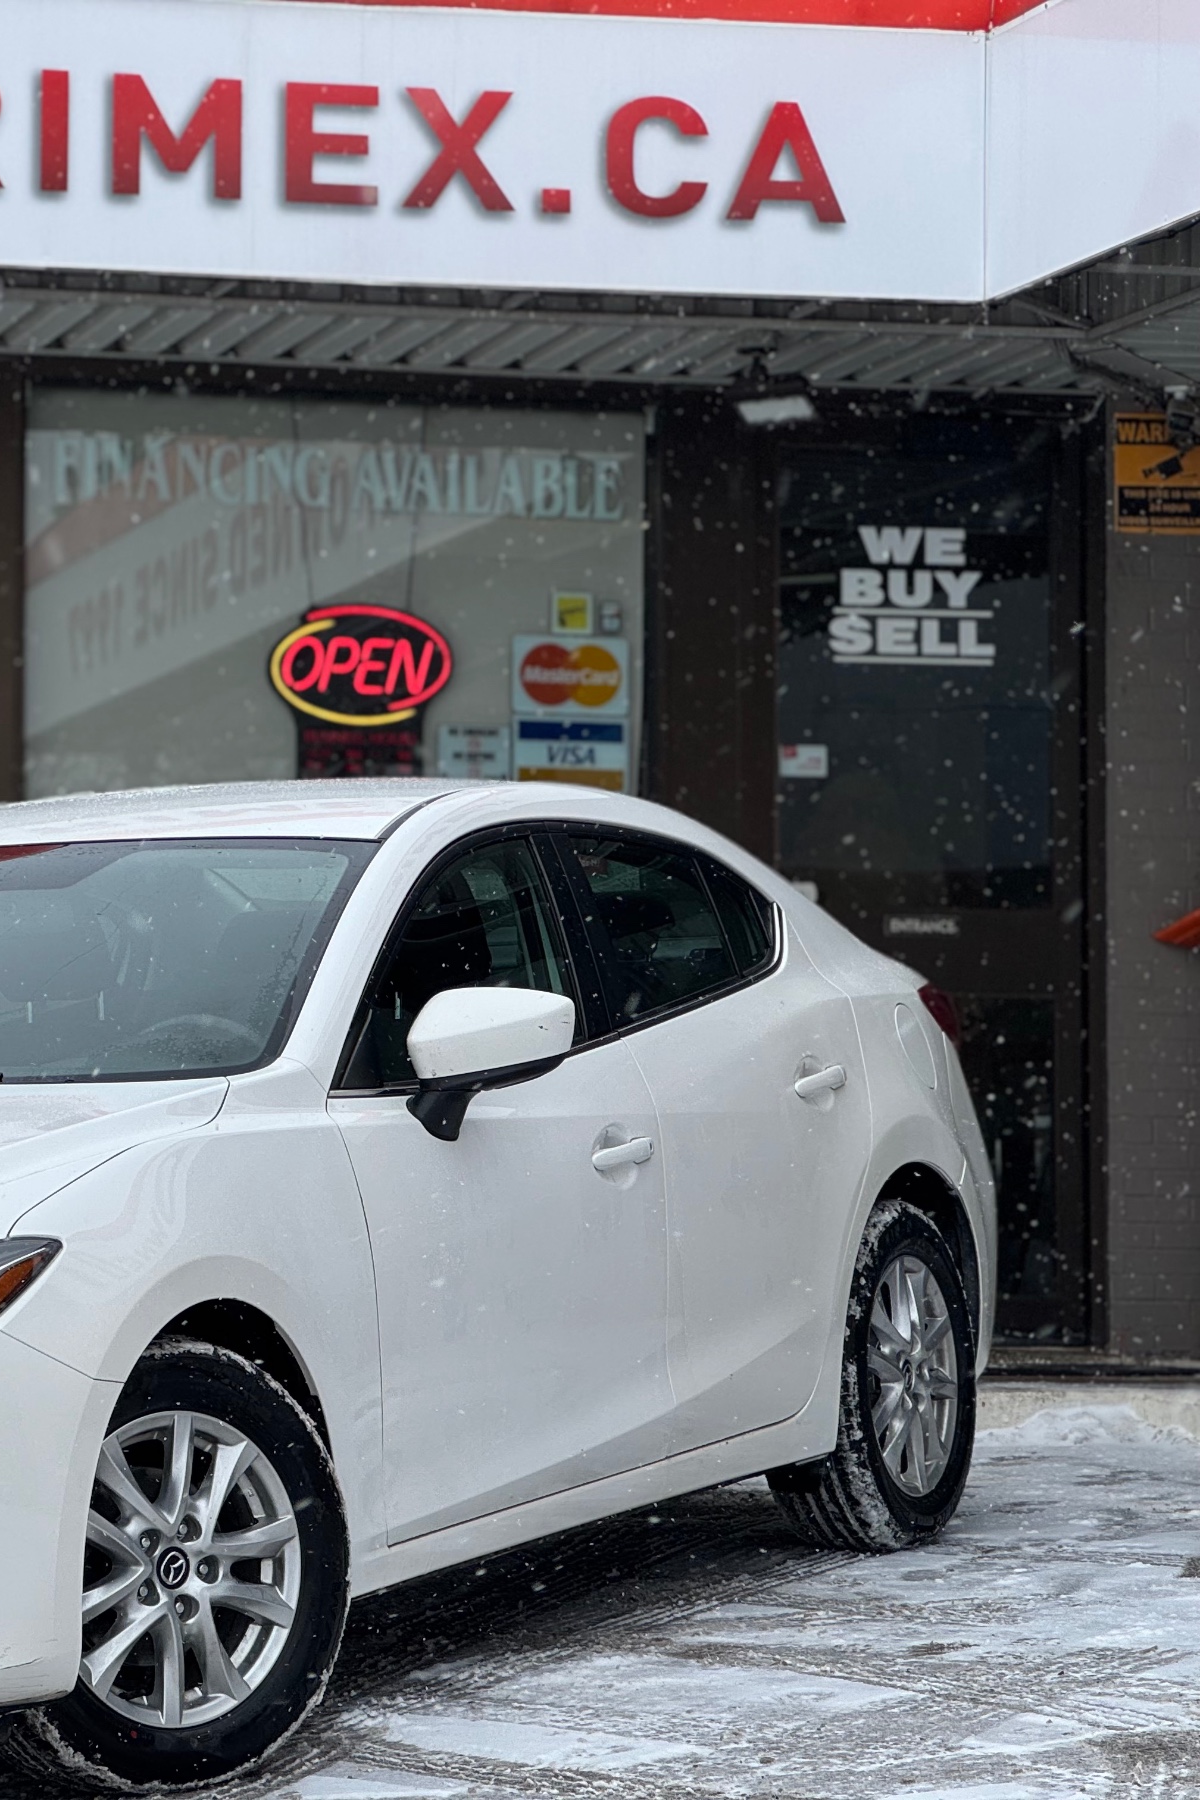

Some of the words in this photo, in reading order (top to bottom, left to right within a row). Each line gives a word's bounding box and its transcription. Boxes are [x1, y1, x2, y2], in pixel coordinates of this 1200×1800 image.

[55, 437, 329, 505] FINANCING
[354, 454, 623, 518] AVAILABLE
[858, 526, 967, 566] WE
[839, 568, 981, 608] BUY
[828, 619, 996, 656] SELL
[282, 636, 434, 695] OPEN
[522, 662, 621, 687] MasterCard
[546, 744, 597, 766] VISA
